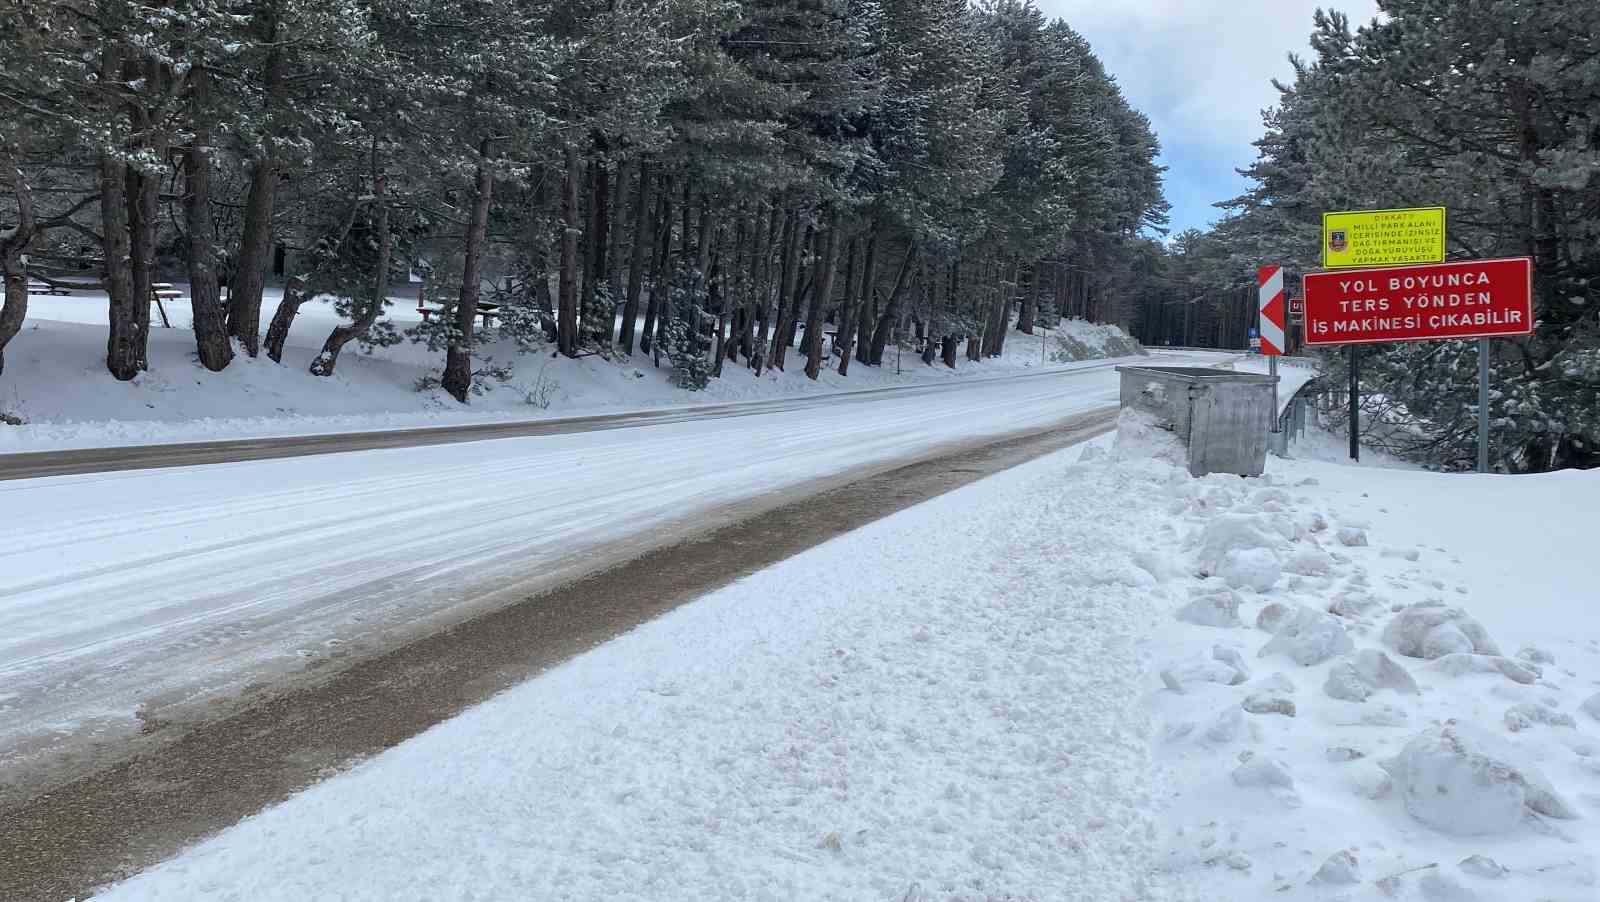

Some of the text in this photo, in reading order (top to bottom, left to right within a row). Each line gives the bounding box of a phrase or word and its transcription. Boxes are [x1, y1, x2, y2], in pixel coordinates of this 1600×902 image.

[1340, 271, 1490, 294] YOL BOYUNCA
[1339, 292, 1491, 313] TERS YÖNDEN
[1313, 308, 1522, 333] İŞ MAKİNESİ ÇIKABİLİR
